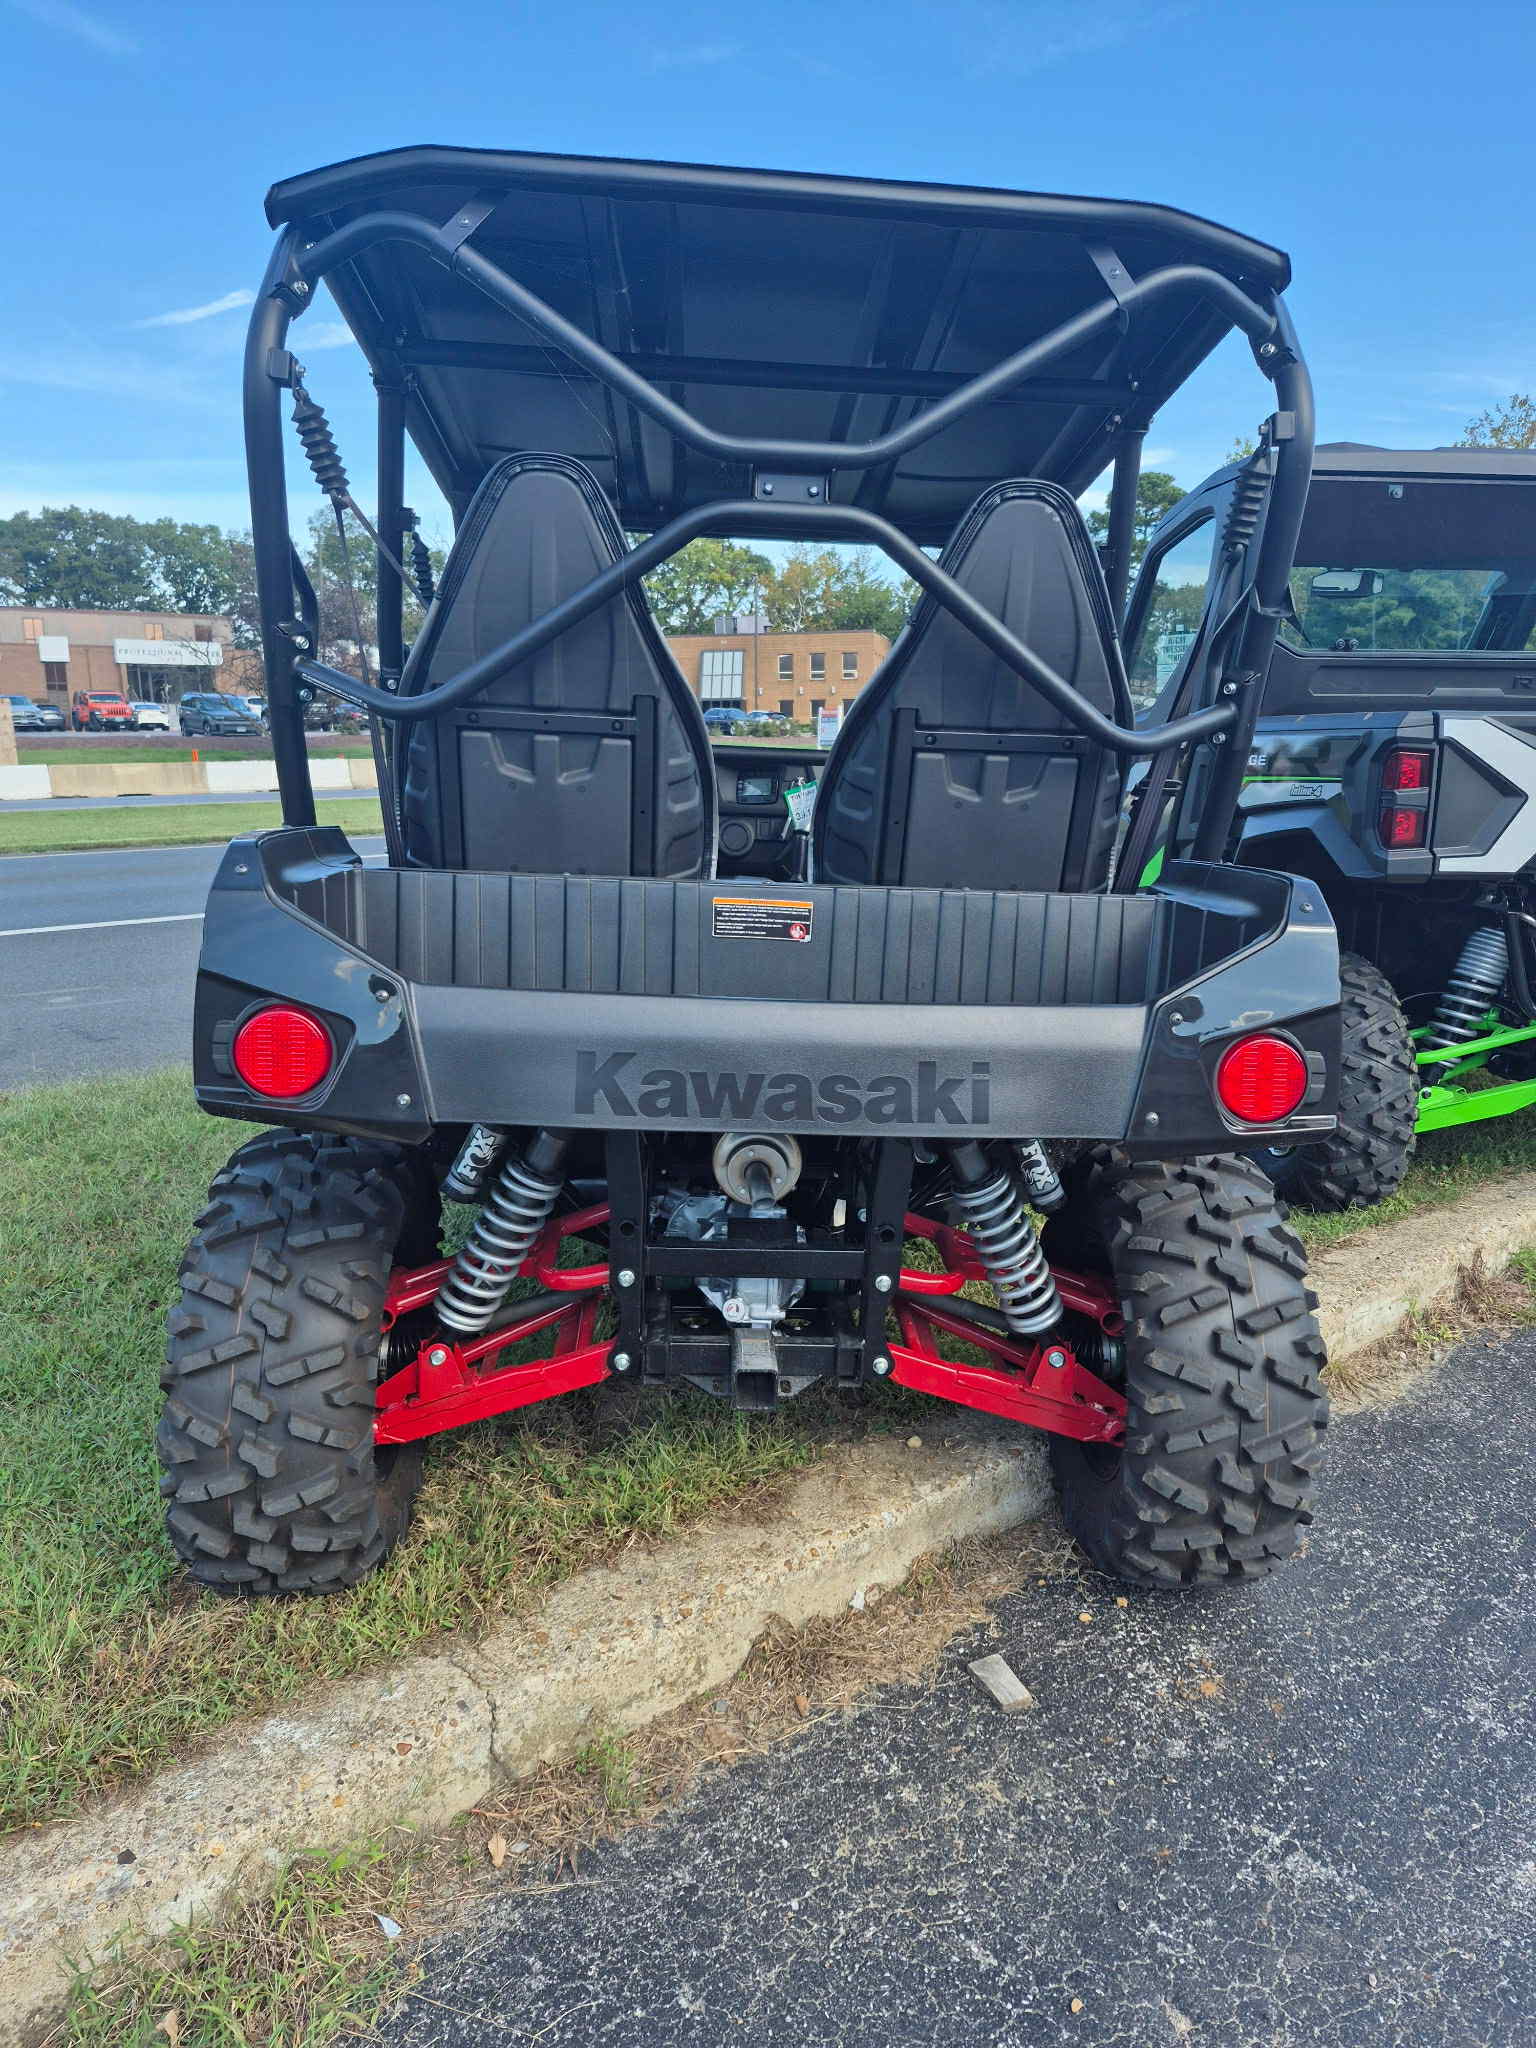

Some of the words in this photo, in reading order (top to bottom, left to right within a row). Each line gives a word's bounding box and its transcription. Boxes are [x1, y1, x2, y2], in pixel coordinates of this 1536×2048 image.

[573, 1050, 991, 1125] Kawasaki
[457, 1127, 499, 1181] FOX
[1021, 1138, 1056, 1192] FOX
